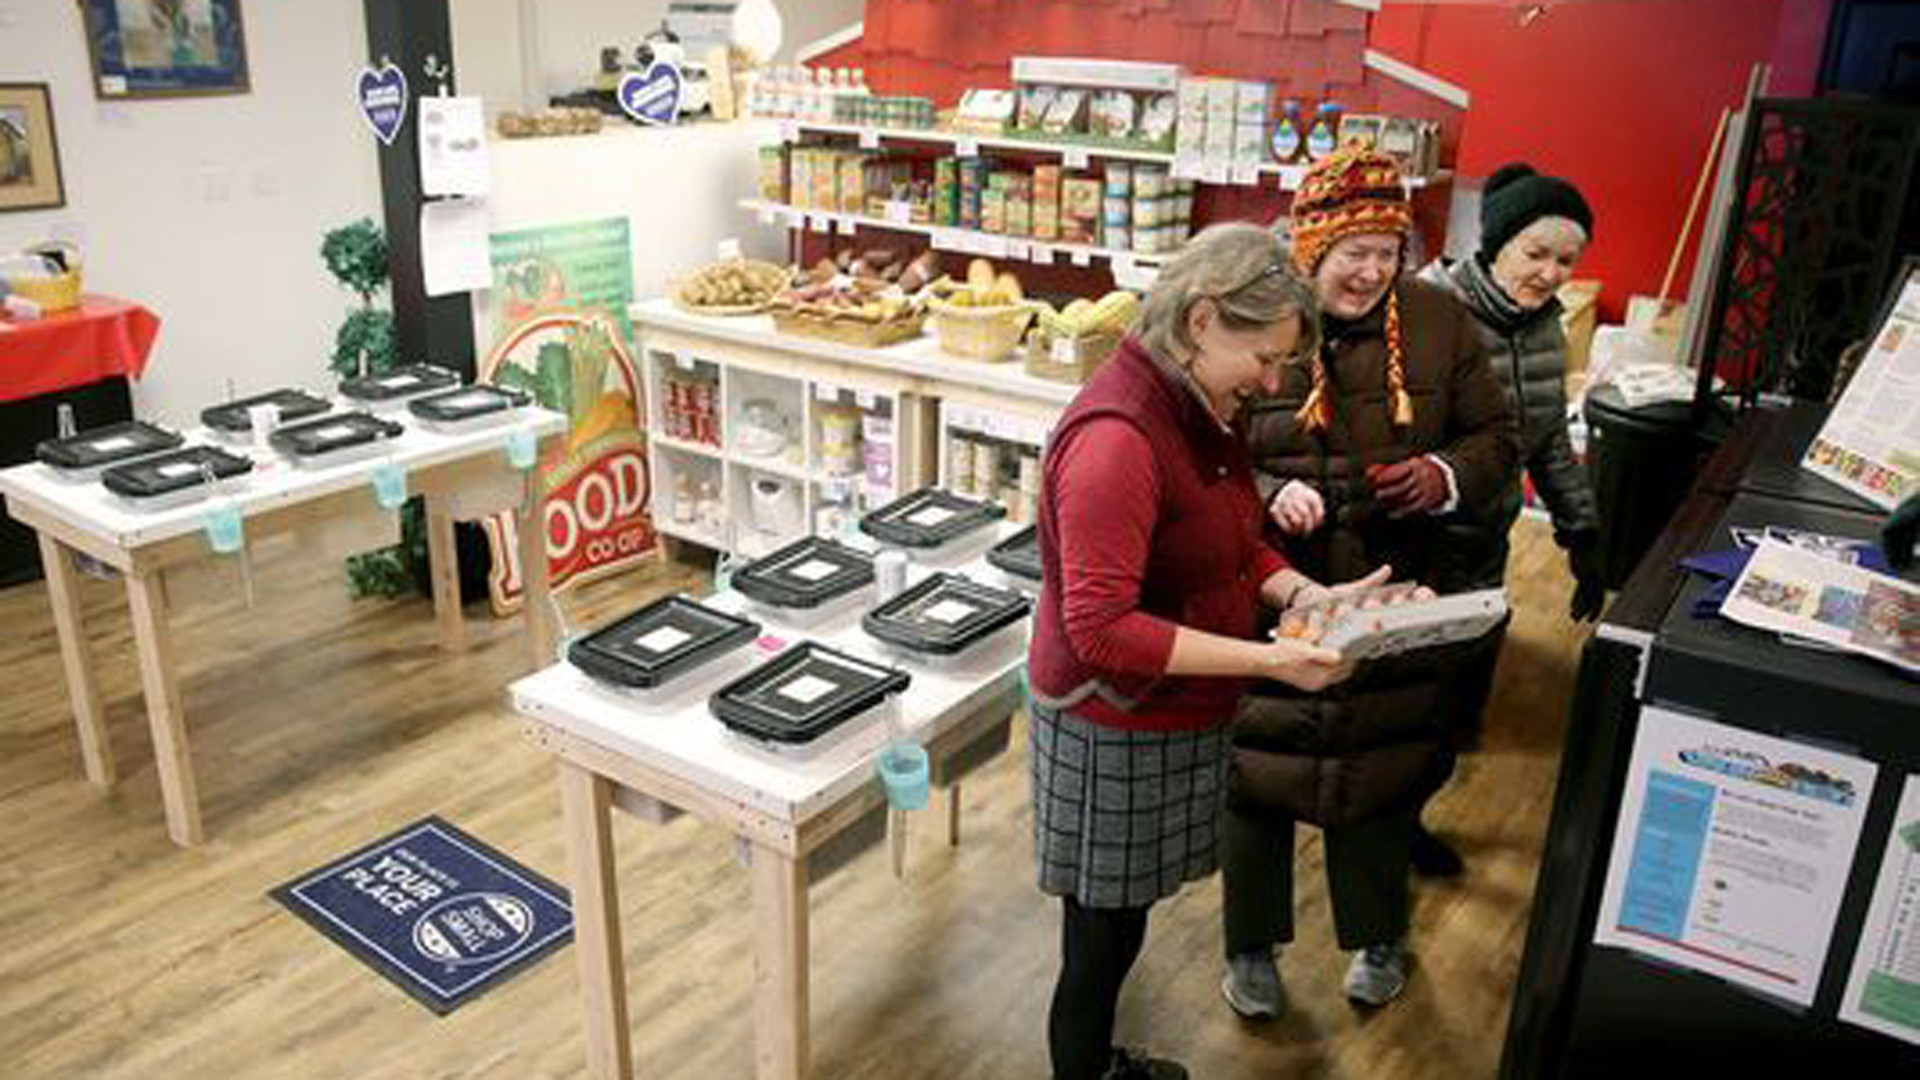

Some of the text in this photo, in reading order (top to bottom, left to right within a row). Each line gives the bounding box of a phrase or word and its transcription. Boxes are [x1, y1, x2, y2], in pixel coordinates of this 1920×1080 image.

[343, 867, 418, 915] PLACE
[372, 856, 442, 901] YOUR
[440, 910, 486, 952] SMALL
[462, 906, 505, 939] SHOP
